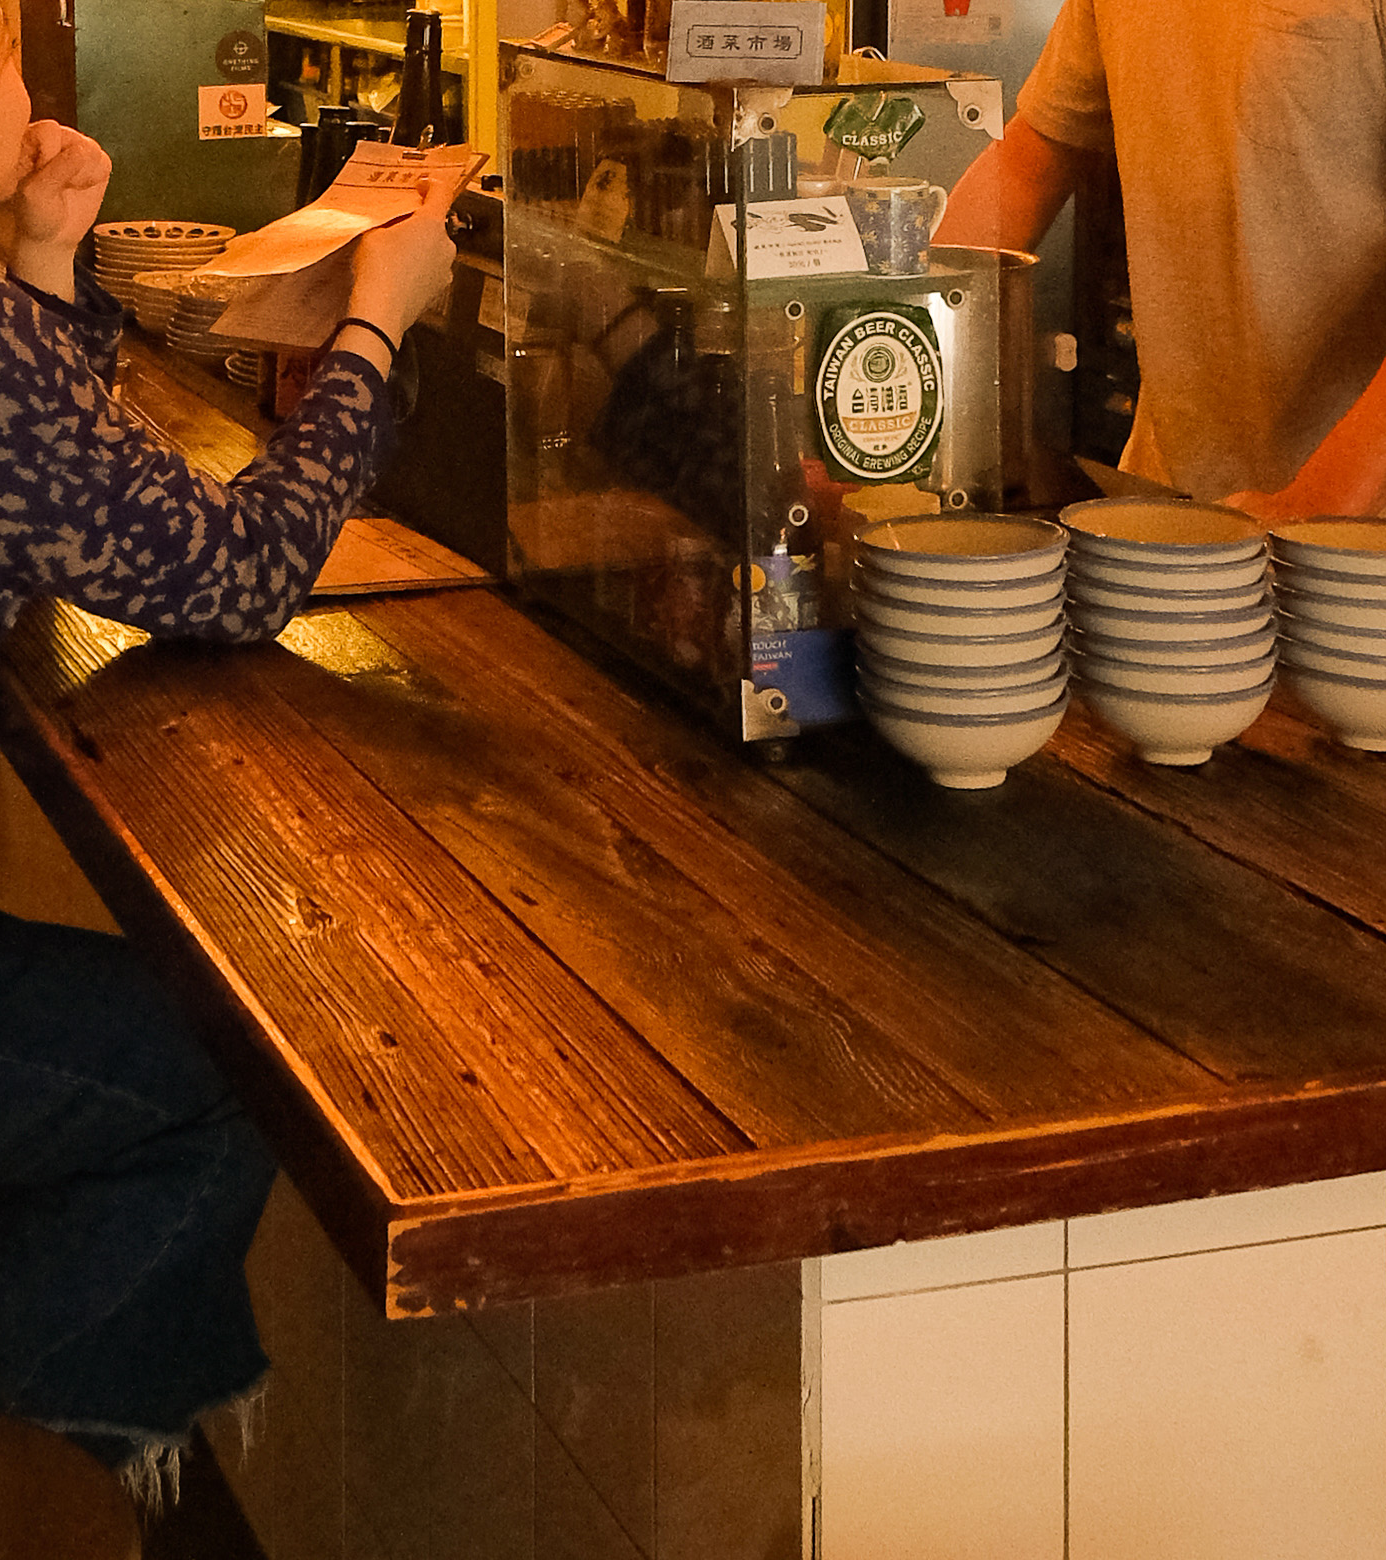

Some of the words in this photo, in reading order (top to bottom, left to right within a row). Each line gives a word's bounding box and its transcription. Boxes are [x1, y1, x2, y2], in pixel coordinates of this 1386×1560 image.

[695, 34, 794, 52] 酒菜市場
[841, 130, 904, 147] CLASSIC
[823, 335, 854, 402] TAIWAN
[853, 320, 897, 341] BEER
[898, 328, 936, 393] CLASSIC
[848, 415, 913, 432] CLASSIC
[828, 423, 862, 465] ORIGINAL
[907, 415, 932, 453] RECIPE
